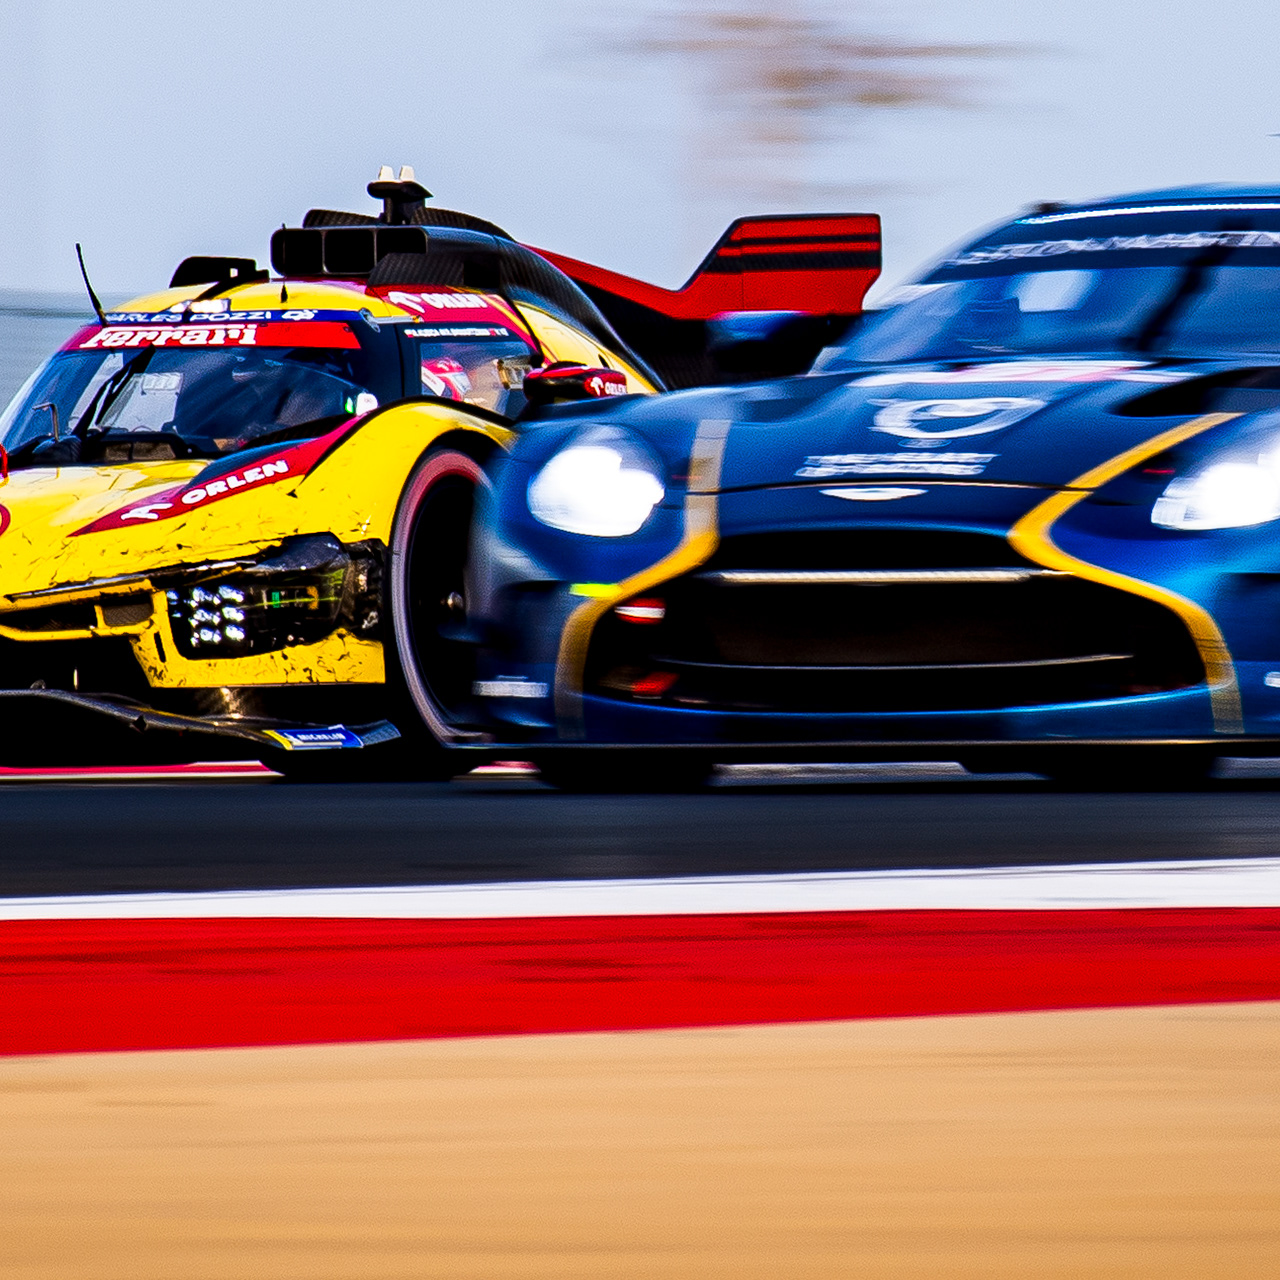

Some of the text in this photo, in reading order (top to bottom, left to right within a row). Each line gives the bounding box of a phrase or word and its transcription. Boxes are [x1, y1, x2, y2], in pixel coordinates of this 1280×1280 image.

[190, 310, 272, 322] POZZI
[78, 324, 258, 349] Ferrari
[181, 459, 289, 504] ORLEN
